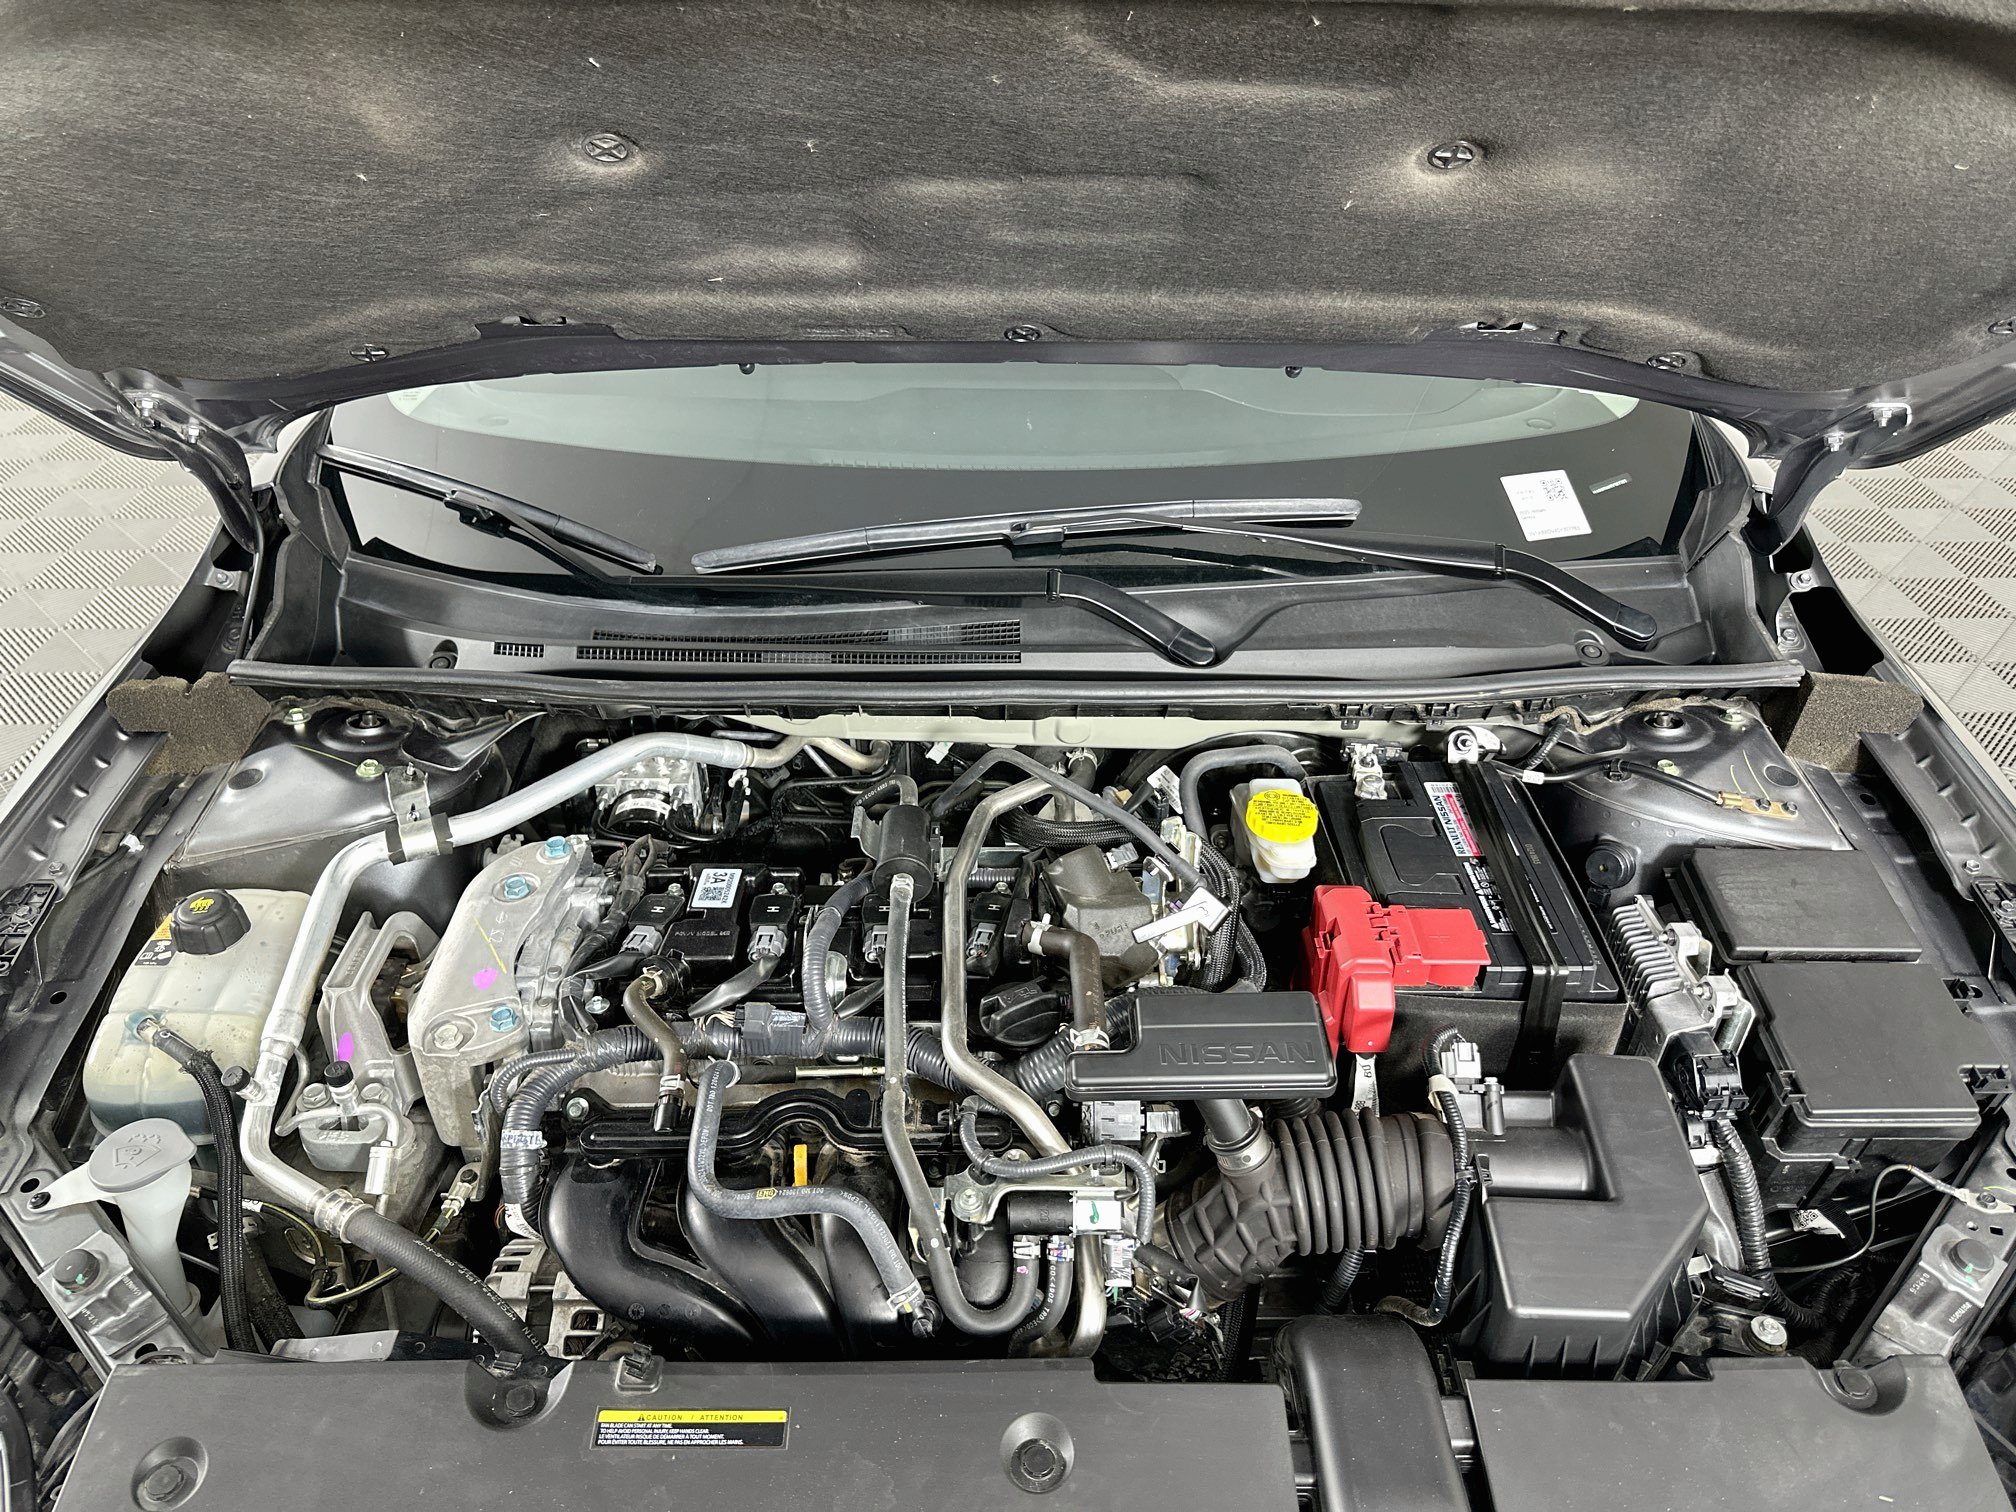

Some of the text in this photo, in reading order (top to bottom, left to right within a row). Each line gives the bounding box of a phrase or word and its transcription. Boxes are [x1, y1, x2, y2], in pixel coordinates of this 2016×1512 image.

[1432, 794, 1453, 825] NISSAN
[710, 871, 728, 884] 3A
[1158, 1041, 1316, 1065] NISSAN
